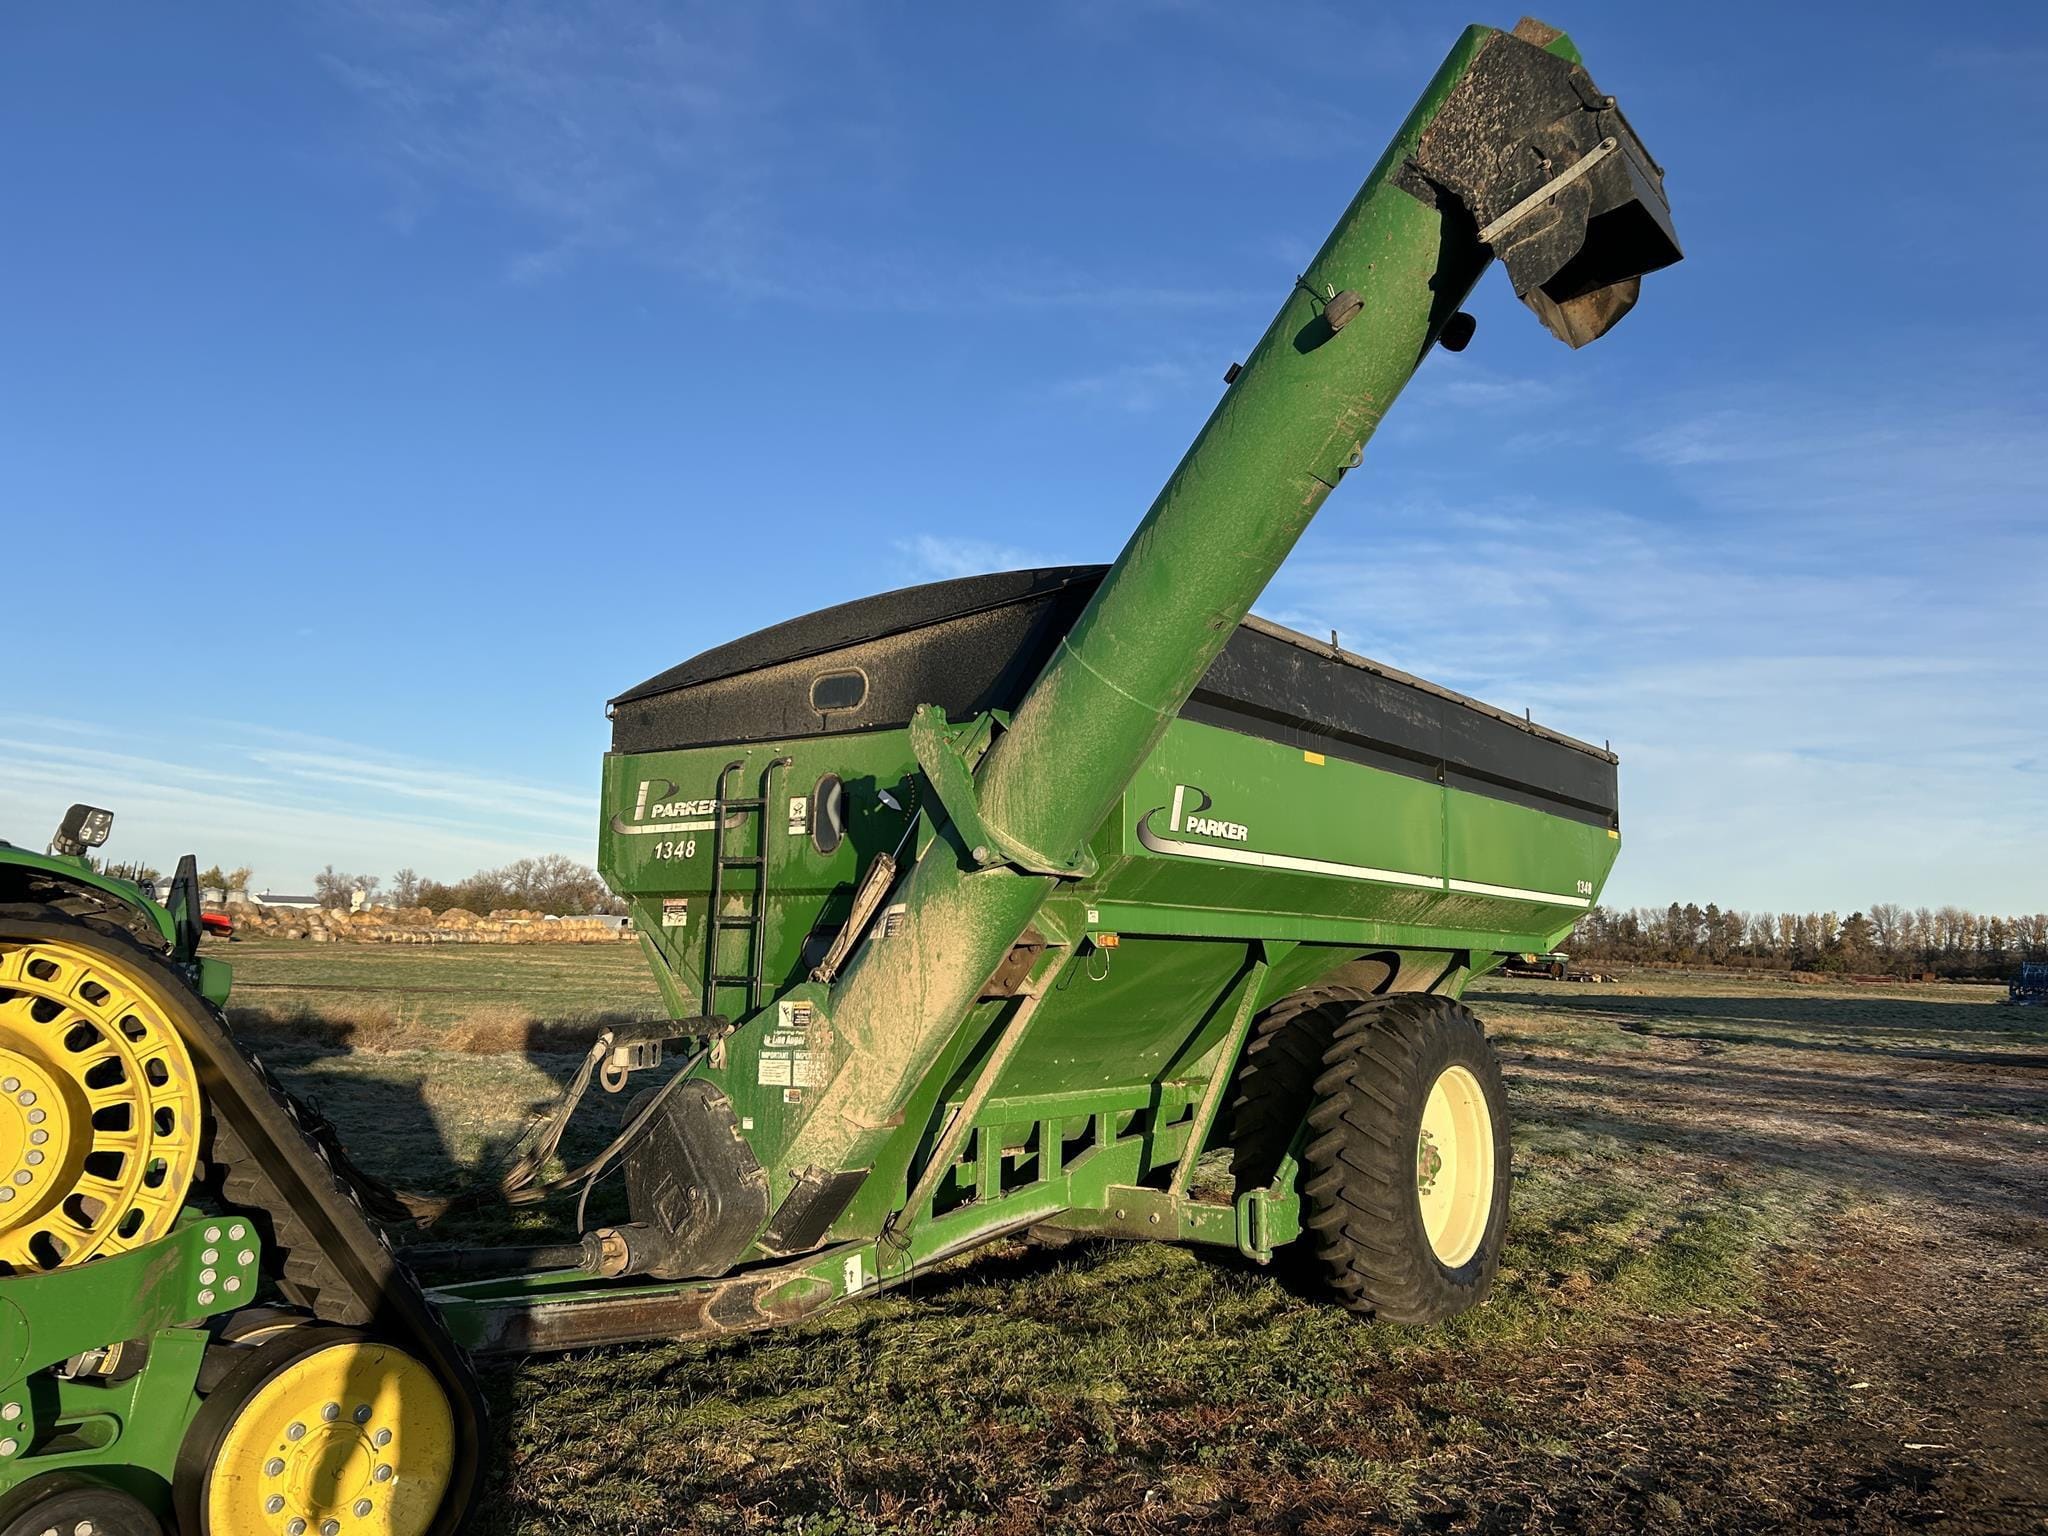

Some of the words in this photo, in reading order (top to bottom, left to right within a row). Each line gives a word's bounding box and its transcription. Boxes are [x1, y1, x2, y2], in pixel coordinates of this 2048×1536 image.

[651, 799, 721, 819] PARKER
[1185, 815, 1249, 842] PARKER
[655, 840, 696, 860] 1348
